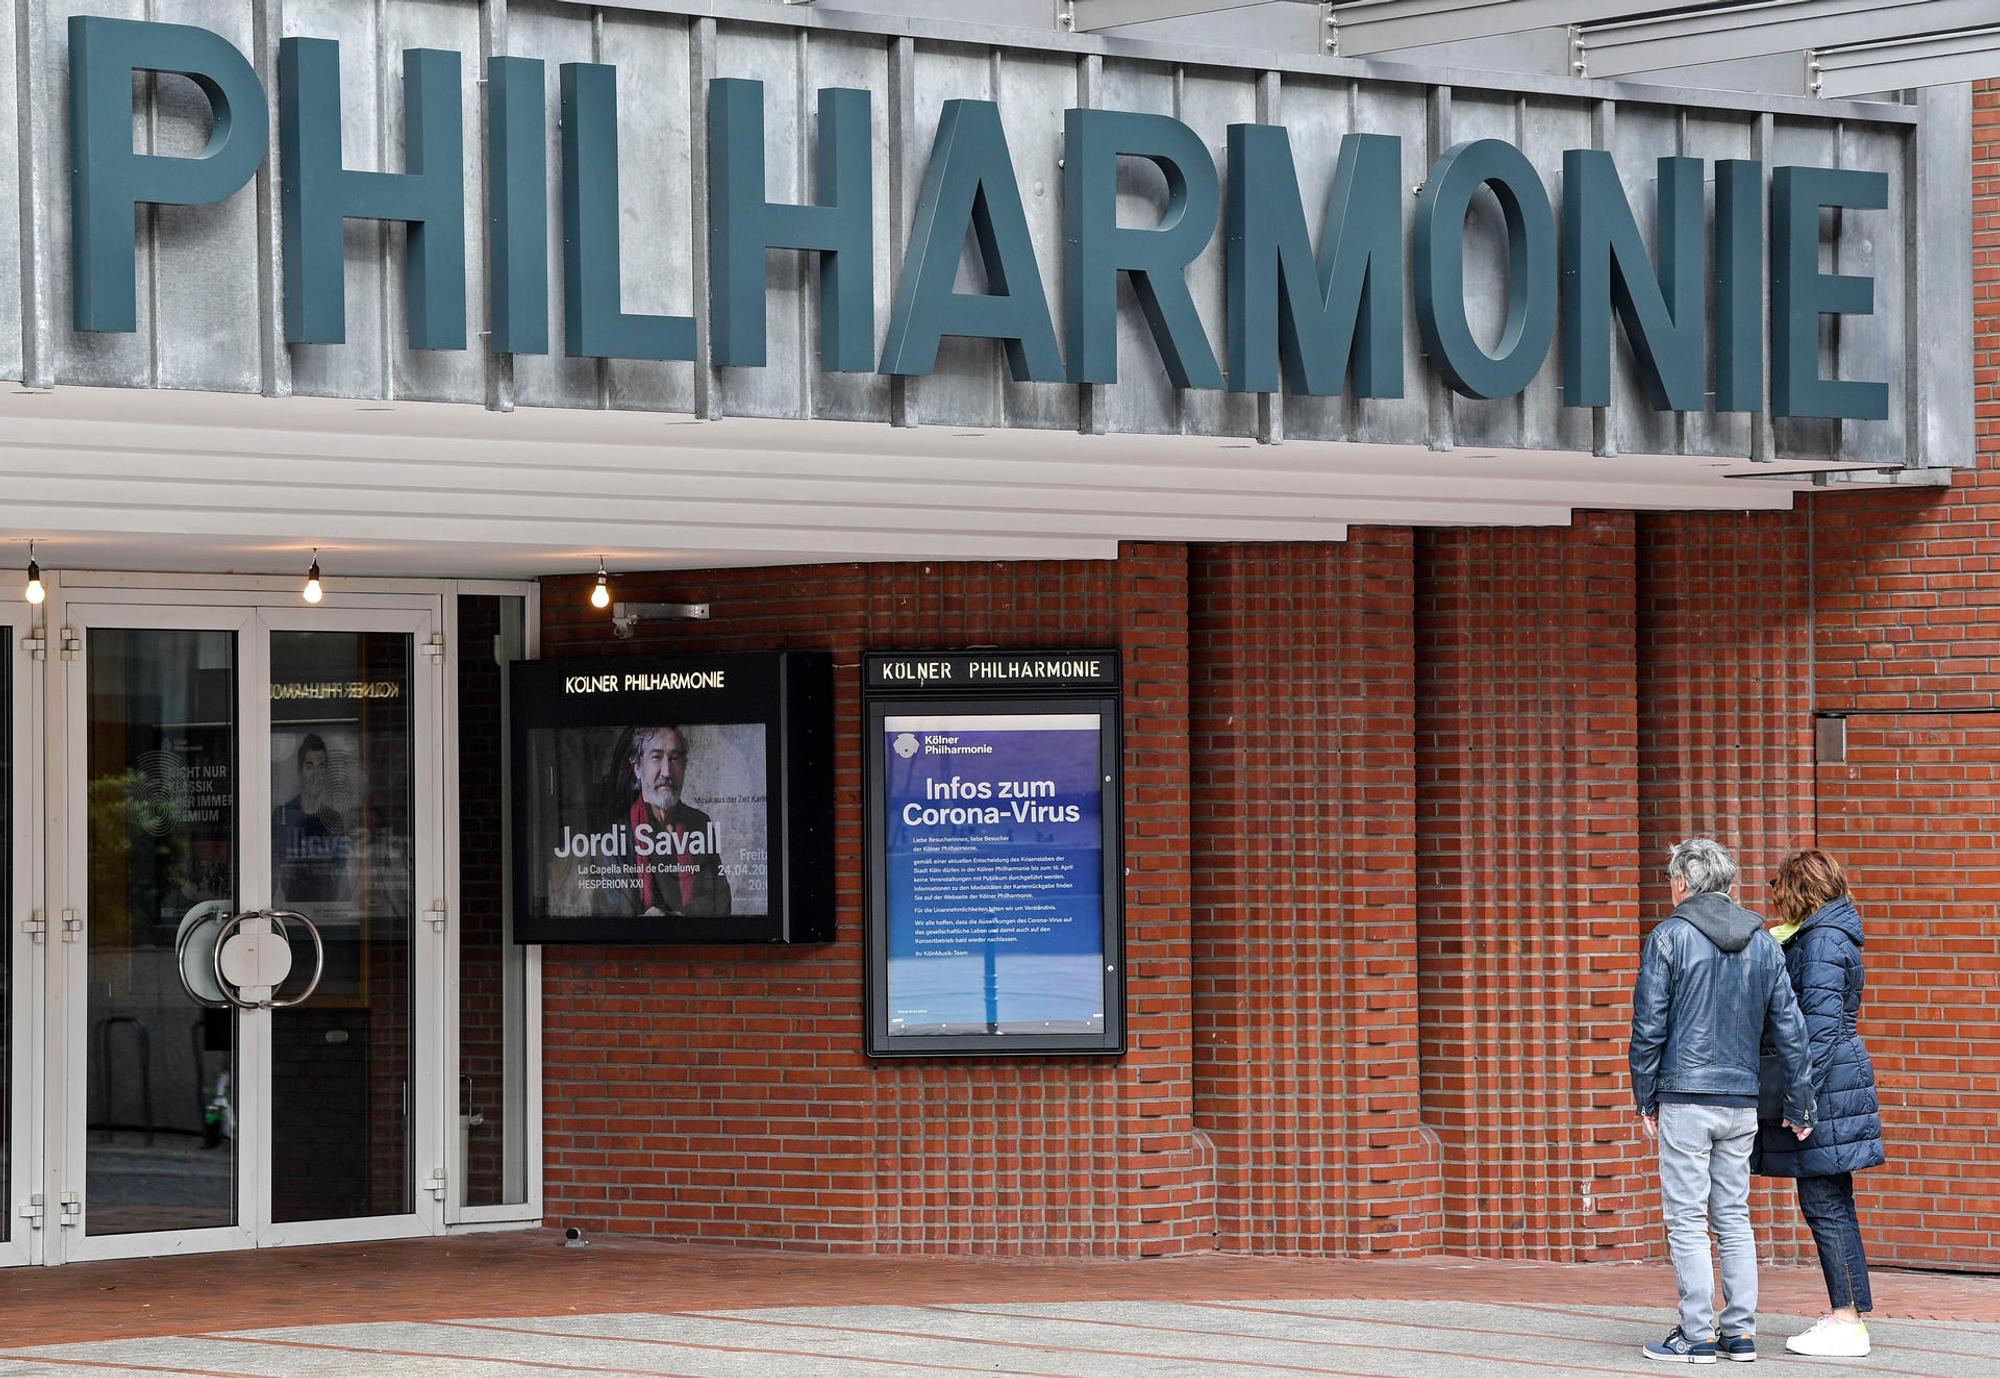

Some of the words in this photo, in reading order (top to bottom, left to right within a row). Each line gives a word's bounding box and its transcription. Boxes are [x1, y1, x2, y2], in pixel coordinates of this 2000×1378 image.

[69, 14, 1888, 421] PHILHARMONIE
[883, 662, 951, 679] KÖLNER
[969, 661, 1100, 678] PHILHARMONIE
[566, 675, 619, 693] KÖLNER
[625, 671, 724, 691] PHILHARMONIE
[925, 735, 959, 745] Kölner
[925, 743, 993, 755] Philharmonie
[202, 765, 226, 778] NUR
[926, 776, 992, 800] Infos
[997, 779, 1056, 798] zum
[171, 809, 219, 823] REMIUM
[902, 800, 1081, 826] Corona-Virus
[554, 823, 626, 858] Jordi
[634, 821, 721, 856] Savall
[740, 848, 767, 861] Freit
[578, 865, 588, 875] La
[590, 864, 621, 877] Capella
[623, 864, 644, 874] Reial
[646, 864, 656, 874] de
[658, 863, 700, 875] Catalunya
[718, 864, 767, 876] 24.04.20
[630, 879, 644, 889] XXI
[748, 879, 767, 891] 20:
